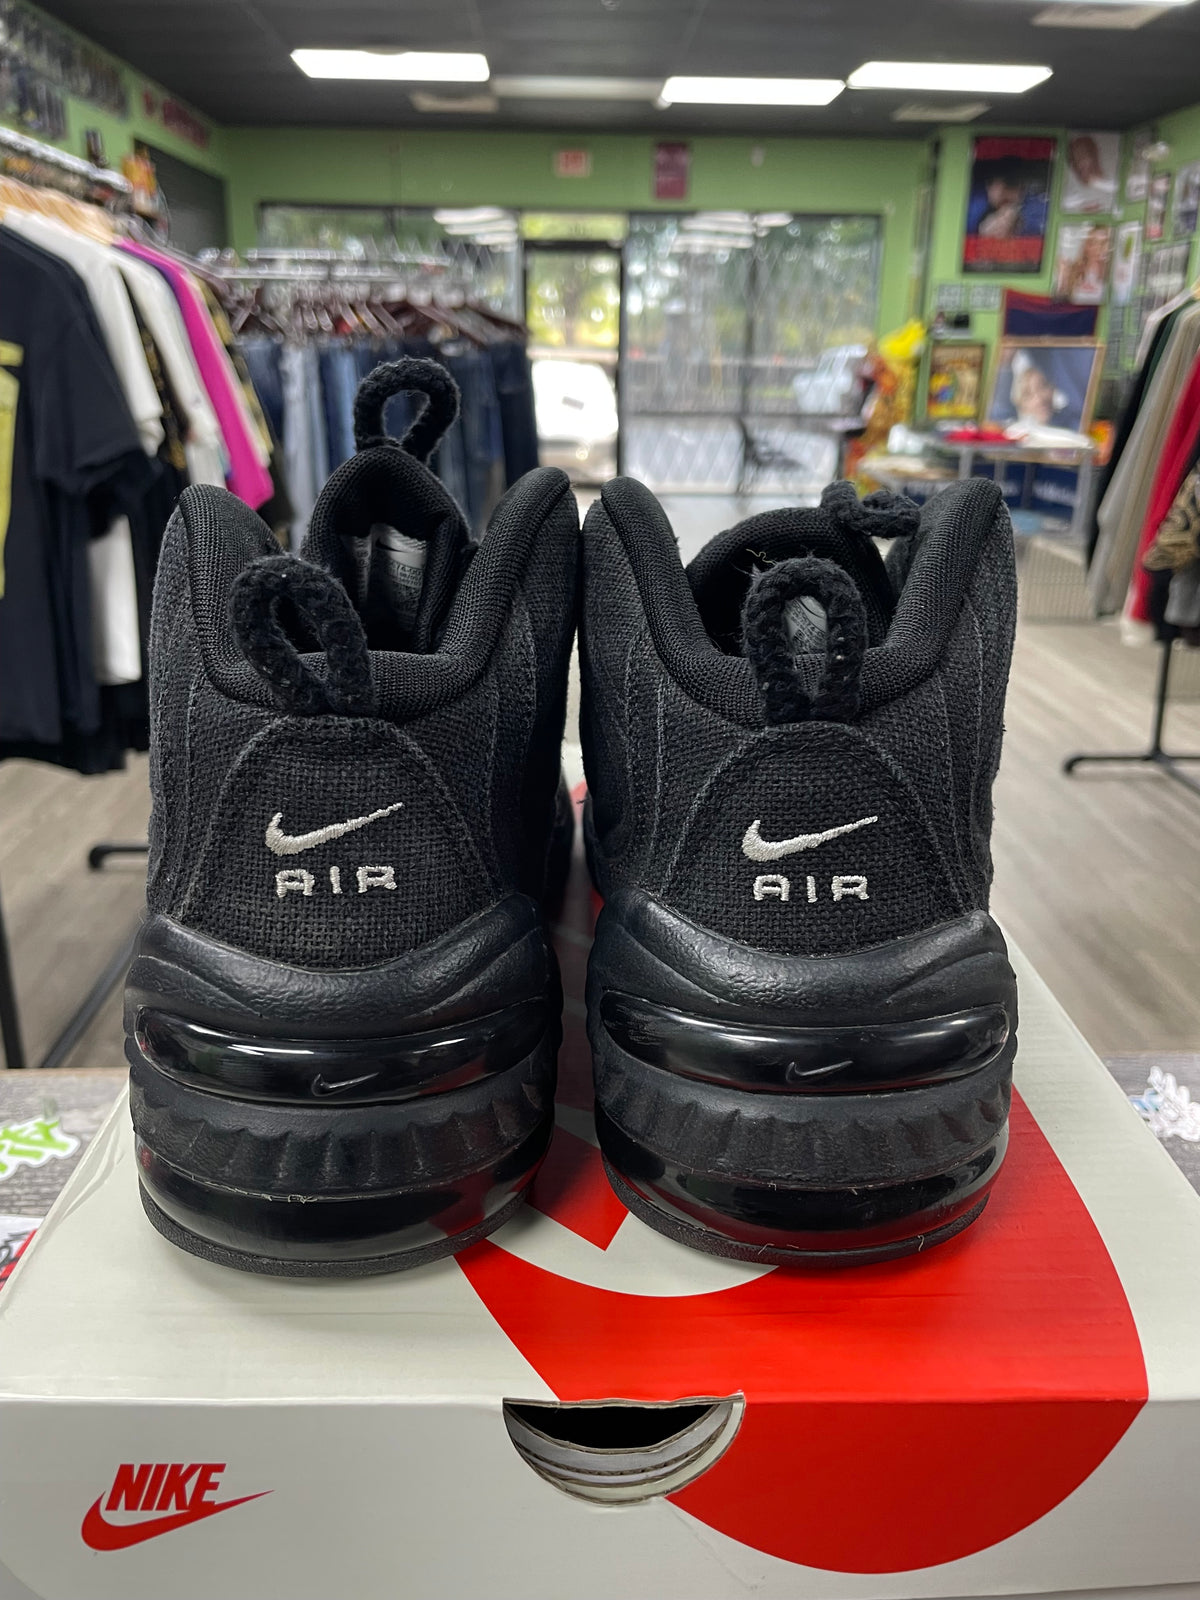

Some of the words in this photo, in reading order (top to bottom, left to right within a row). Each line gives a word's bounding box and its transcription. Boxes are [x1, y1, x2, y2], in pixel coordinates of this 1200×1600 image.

[275, 866, 397, 898] AIR
[753, 874, 869, 903] AIR
[105, 1463, 227, 1511] NIKE
